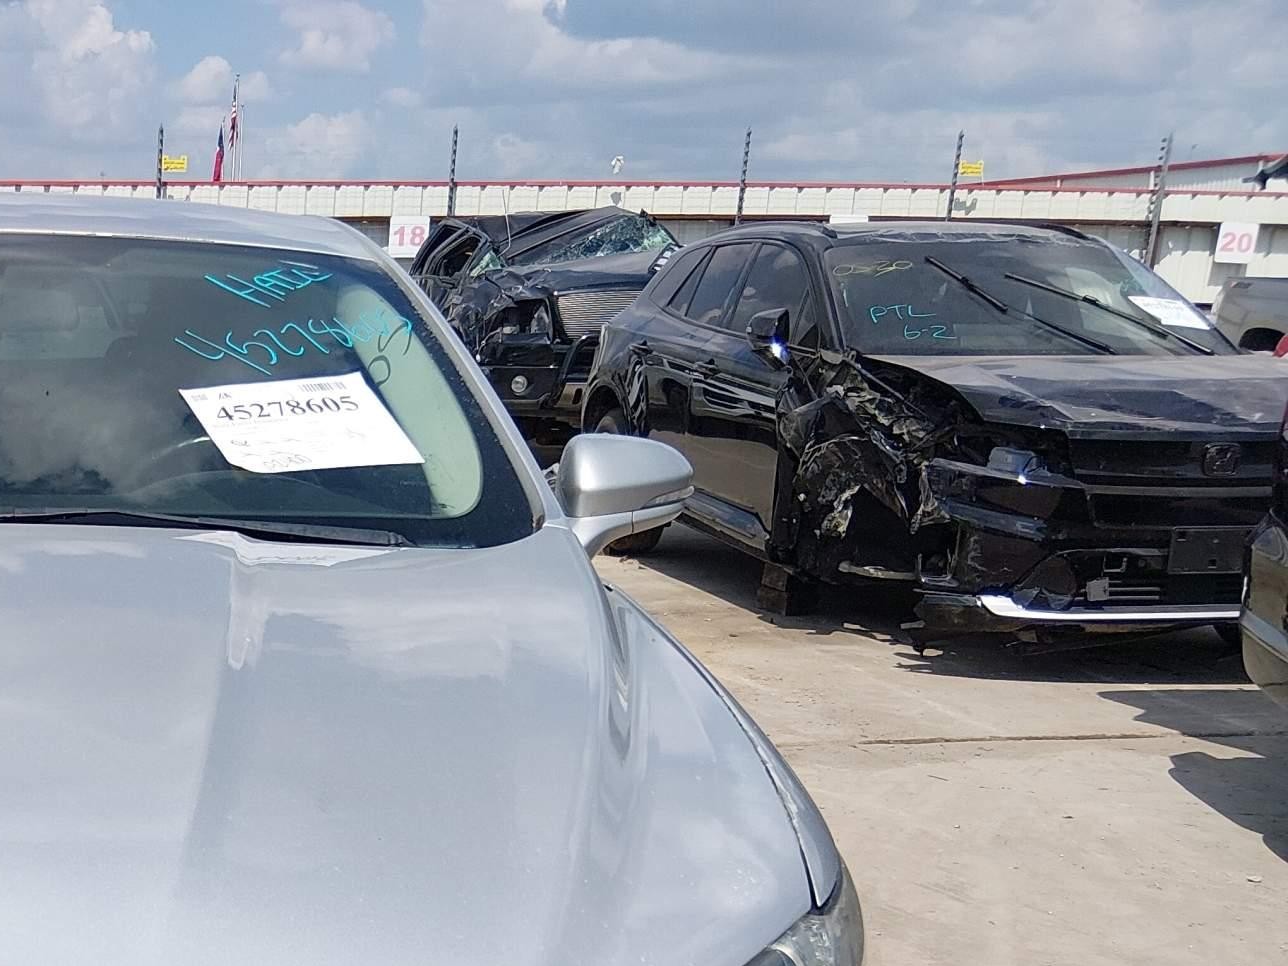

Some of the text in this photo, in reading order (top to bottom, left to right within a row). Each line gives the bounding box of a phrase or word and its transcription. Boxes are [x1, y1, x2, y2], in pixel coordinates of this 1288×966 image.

[393, 225, 425, 247] 18
[1220, 231, 1253, 252] 20
[869, 304, 937, 323] PTL
[903, 325, 958, 340] 6-2
[216, 395, 359, 422] 45278605
